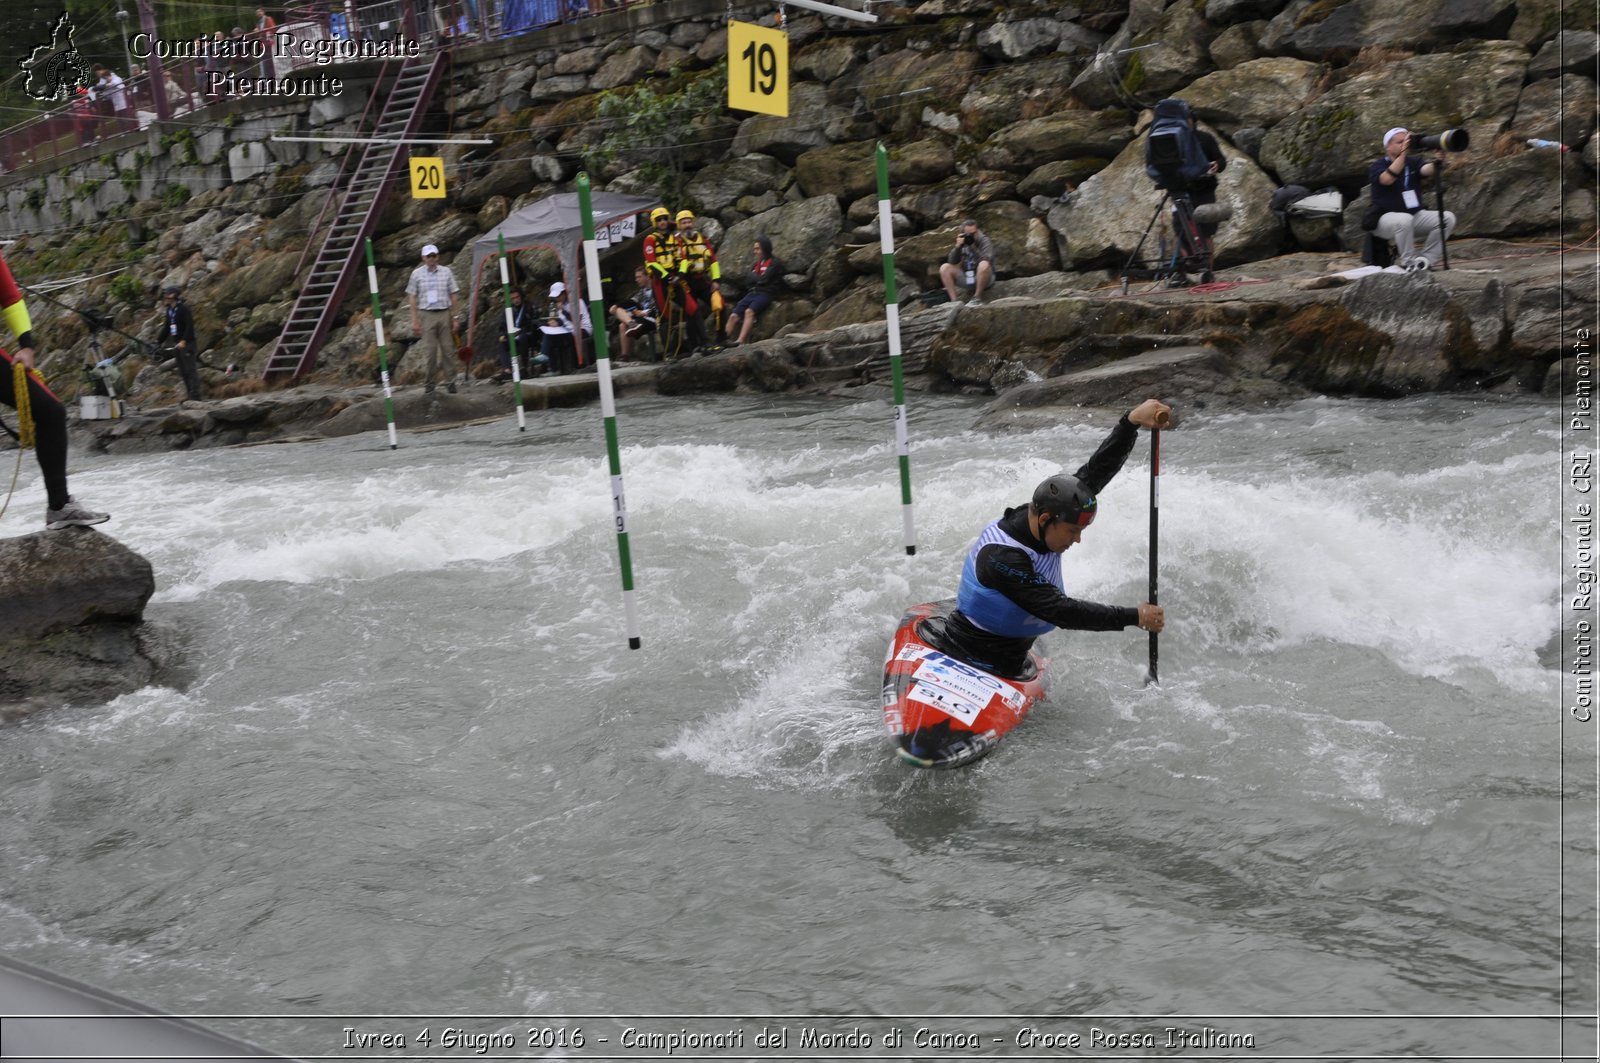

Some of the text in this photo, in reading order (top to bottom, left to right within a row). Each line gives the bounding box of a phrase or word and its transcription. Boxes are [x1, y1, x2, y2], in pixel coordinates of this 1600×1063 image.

[742, 41, 777, 96] 19
[417, 165, 440, 190] 20
[595, 230, 609, 241] 22
[919, 688, 971, 715] SLO
